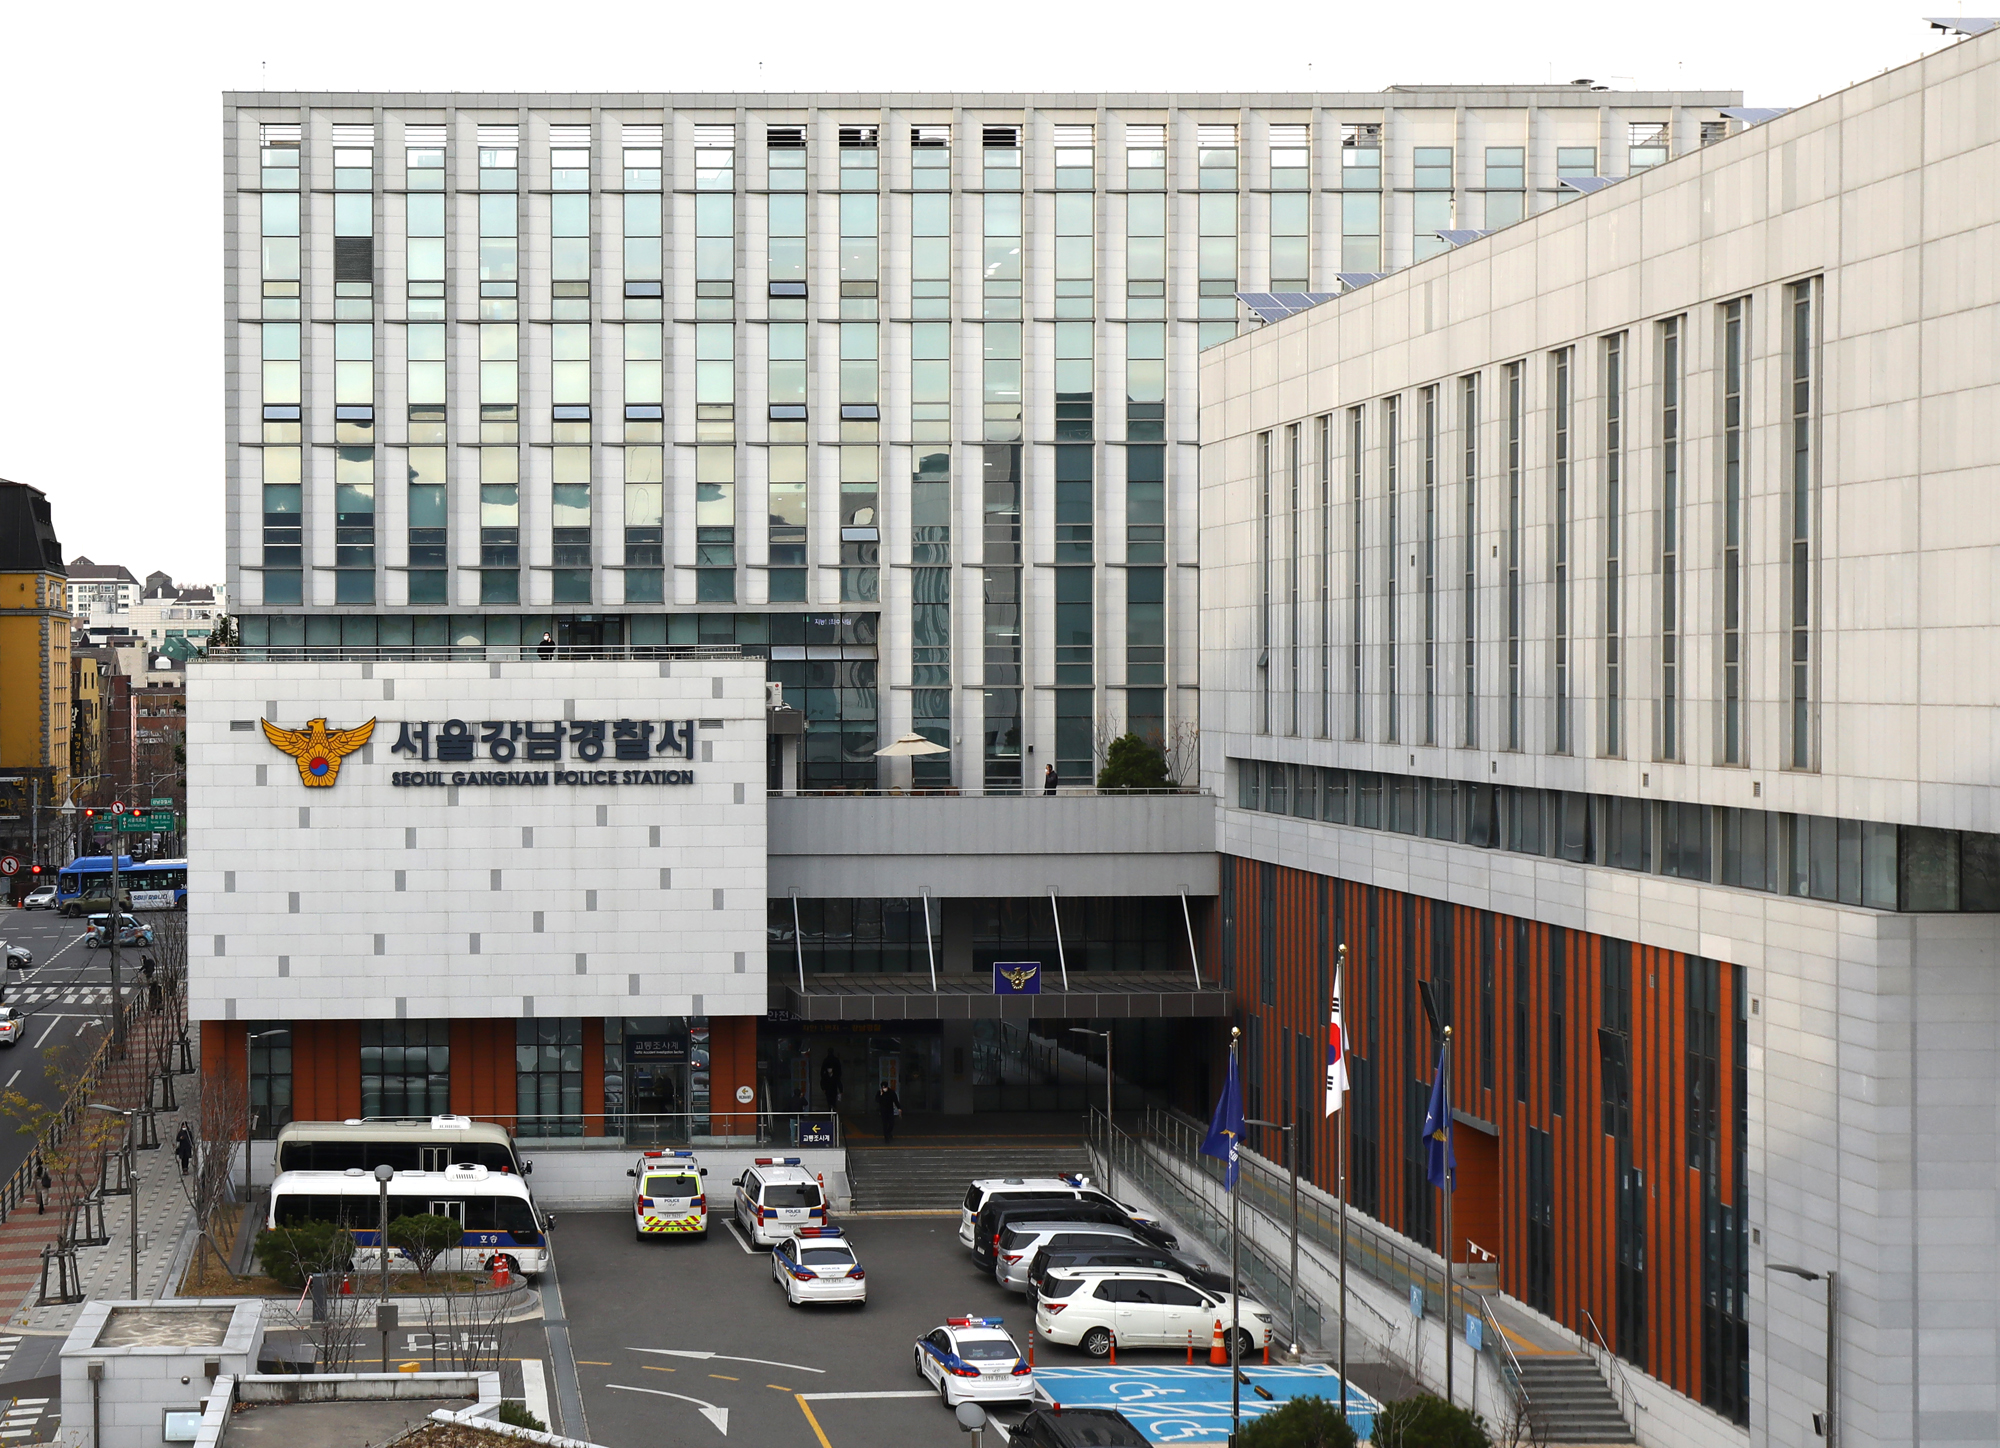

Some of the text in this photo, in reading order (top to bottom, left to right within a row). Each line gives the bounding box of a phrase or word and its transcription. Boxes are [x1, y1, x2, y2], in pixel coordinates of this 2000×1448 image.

[391, 718, 694, 763] 서울강남경찰서
[391, 770, 694, 787] SEOUL GANGNAM POLICE STATION
[635, 1041, 679, 1050] 교통조사계
[803, 1134, 830, 1142] 교통조사계
[480, 1234, 498, 1244] 호송
